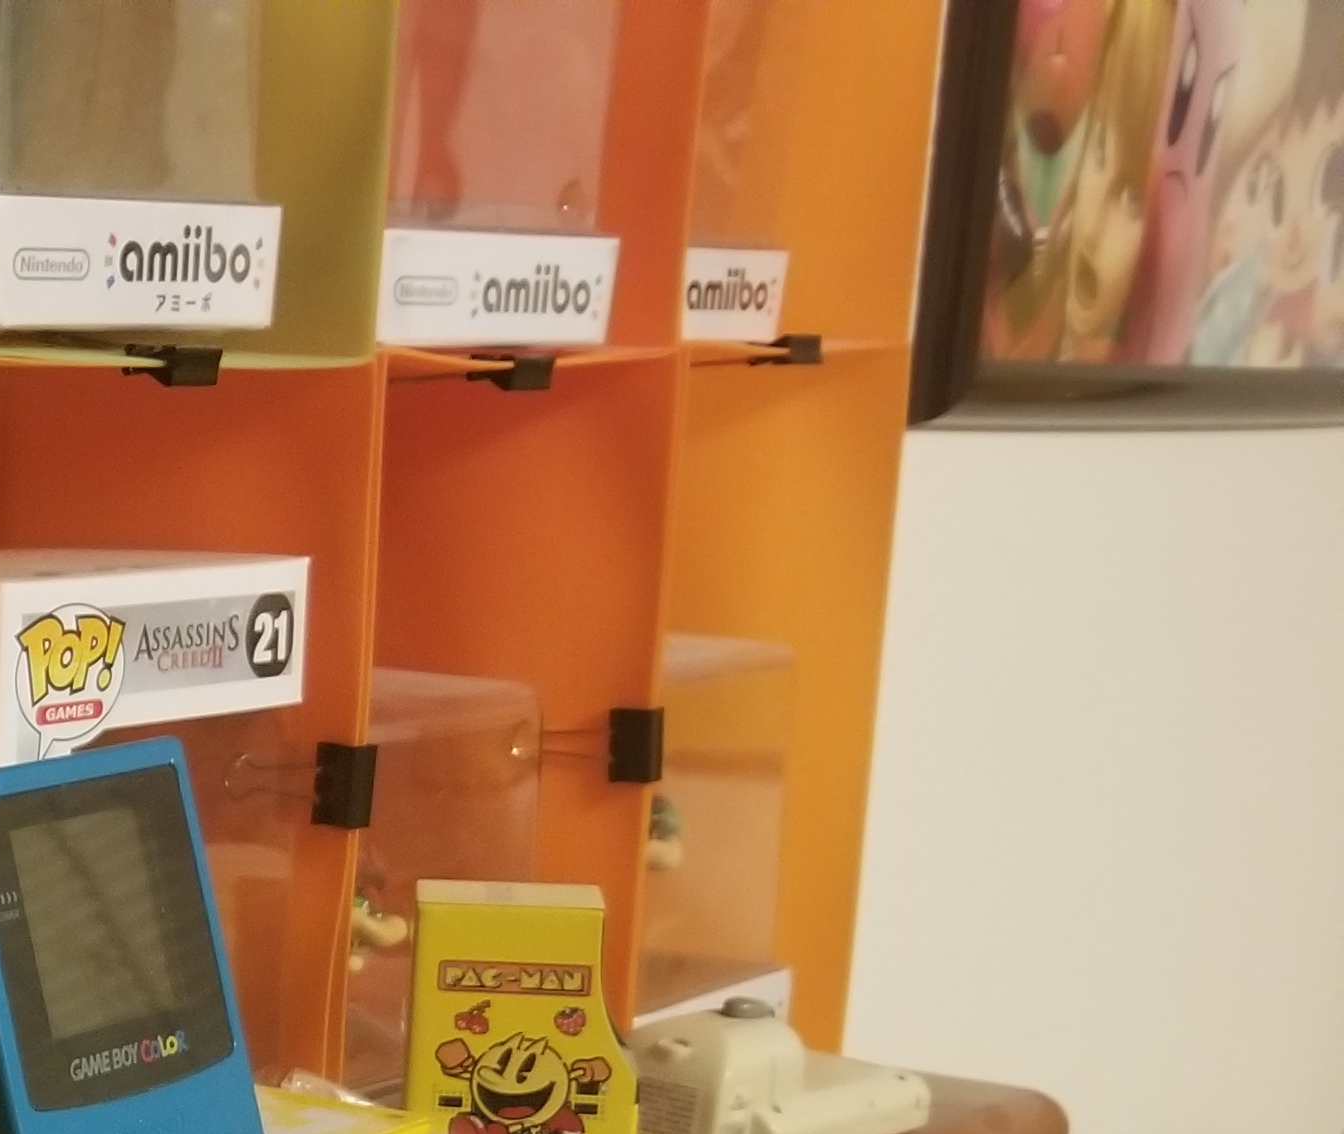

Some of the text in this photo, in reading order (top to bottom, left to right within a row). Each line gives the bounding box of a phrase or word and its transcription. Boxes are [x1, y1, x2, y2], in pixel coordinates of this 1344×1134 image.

[19, 254, 84, 274] Nintendo
[119, 224, 252, 284] amiibo
[155, 292, 213, 313] アミーボ
[481, 263, 592, 315] amiibo
[686, 268, 769, 312] amiibo
[15, 613, 126, 707] POP!
[252, 609, 291, 665] 21
[45, 703, 95, 721] GAMES
[444, 965, 585, 991] PAC-MAN
[69, 1029, 189, 1082] GAME BOY COLOR
